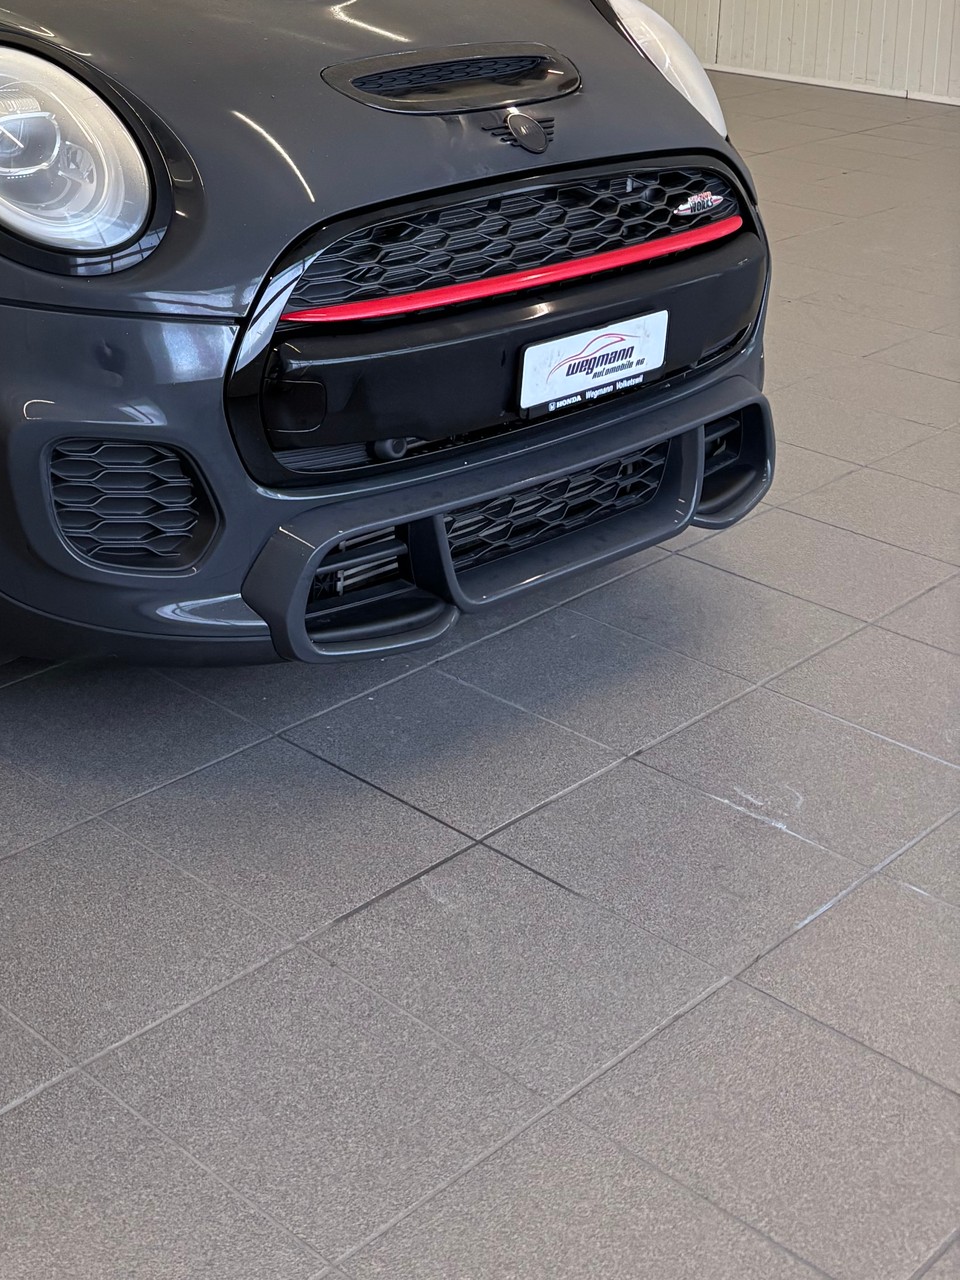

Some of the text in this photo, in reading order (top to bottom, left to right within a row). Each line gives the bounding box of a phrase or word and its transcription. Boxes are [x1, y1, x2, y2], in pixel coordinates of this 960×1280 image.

[690, 197, 714, 214] WORKS
[565, 345, 635, 377] wegmann
[556, 394, 582, 409] HONDA
[585, 384, 614, 400] Wegmann
